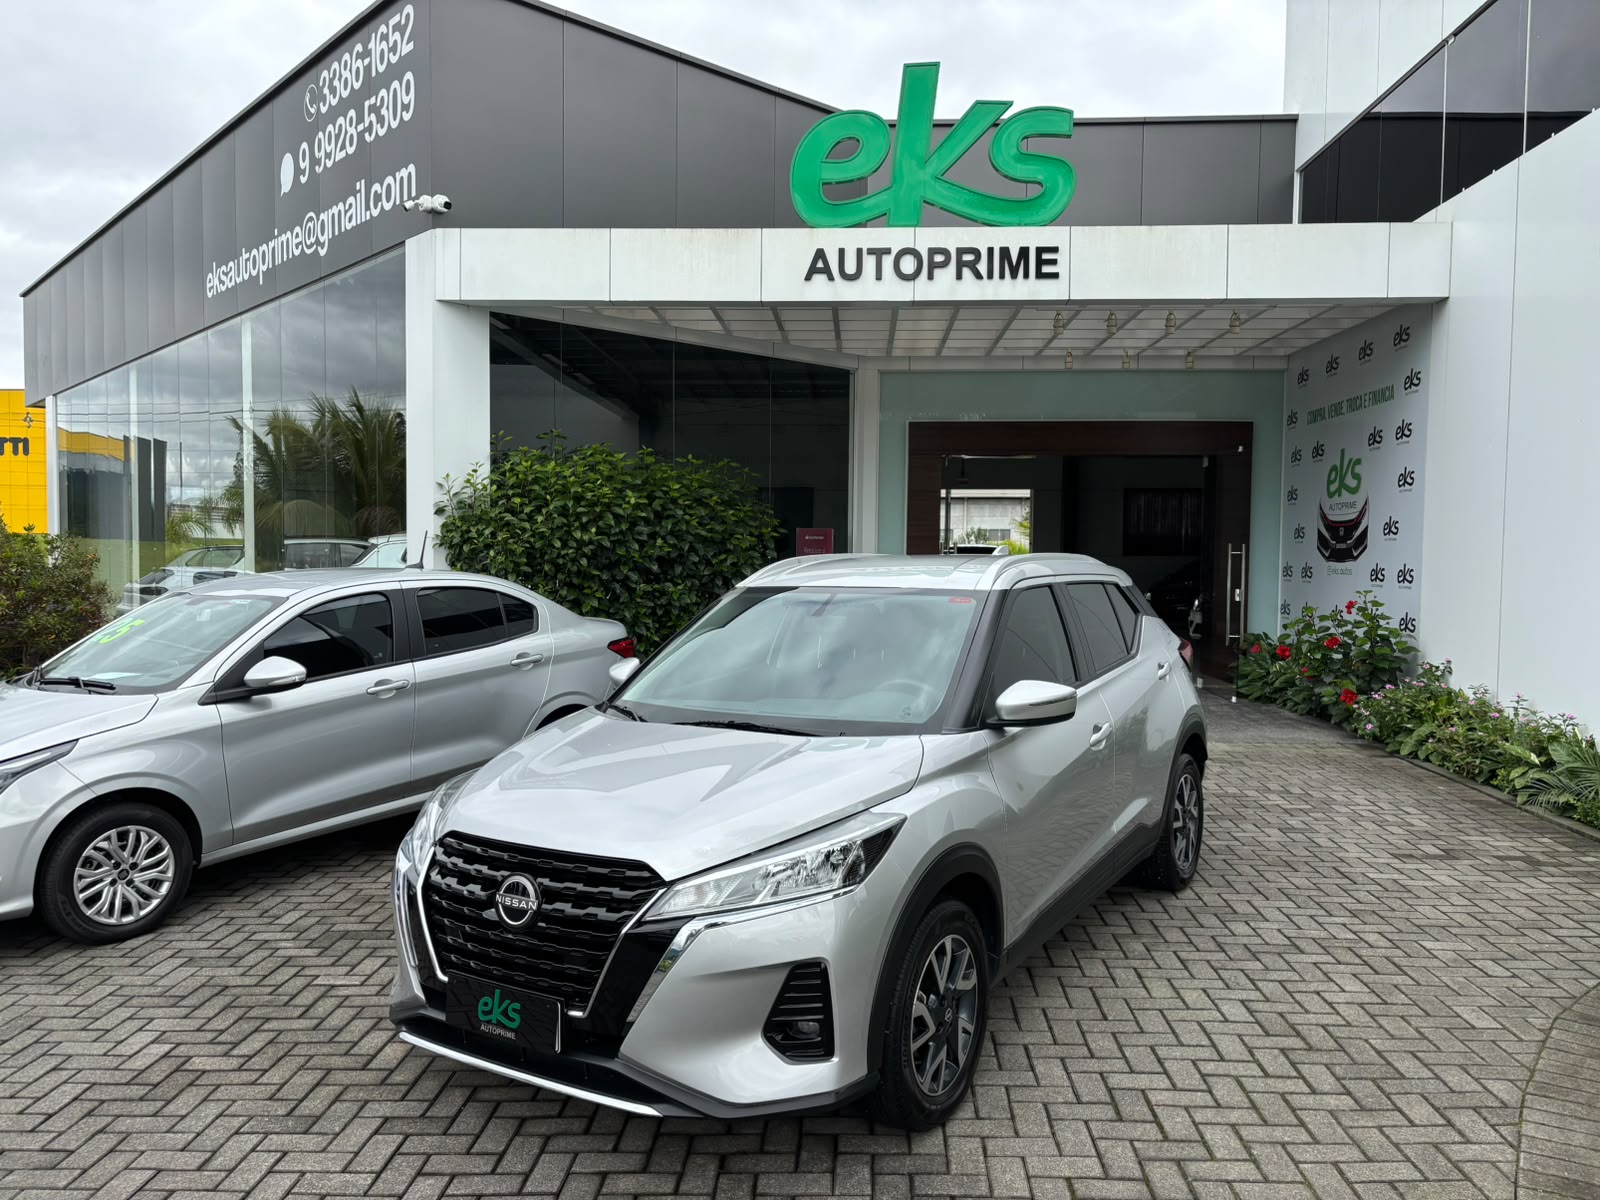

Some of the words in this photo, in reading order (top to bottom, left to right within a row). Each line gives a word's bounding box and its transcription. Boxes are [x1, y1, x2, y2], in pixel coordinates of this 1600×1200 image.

[319, 4, 415, 114] 3386-1652
[299, 141, 309, 184] 9
[315, 71, 415, 174] 9928-5309
[789, 61, 1077, 228] eks
[206, 163, 416, 298] eksautoprime@gmail.com
[804, 246, 1060, 281] AUTOPRIME
[1326, 448, 1362, 499] eks
[495, 894, 537, 911] NISSAN
[478, 989, 521, 1030] eks
[480, 1023, 516, 1040] AUTOPRIME
